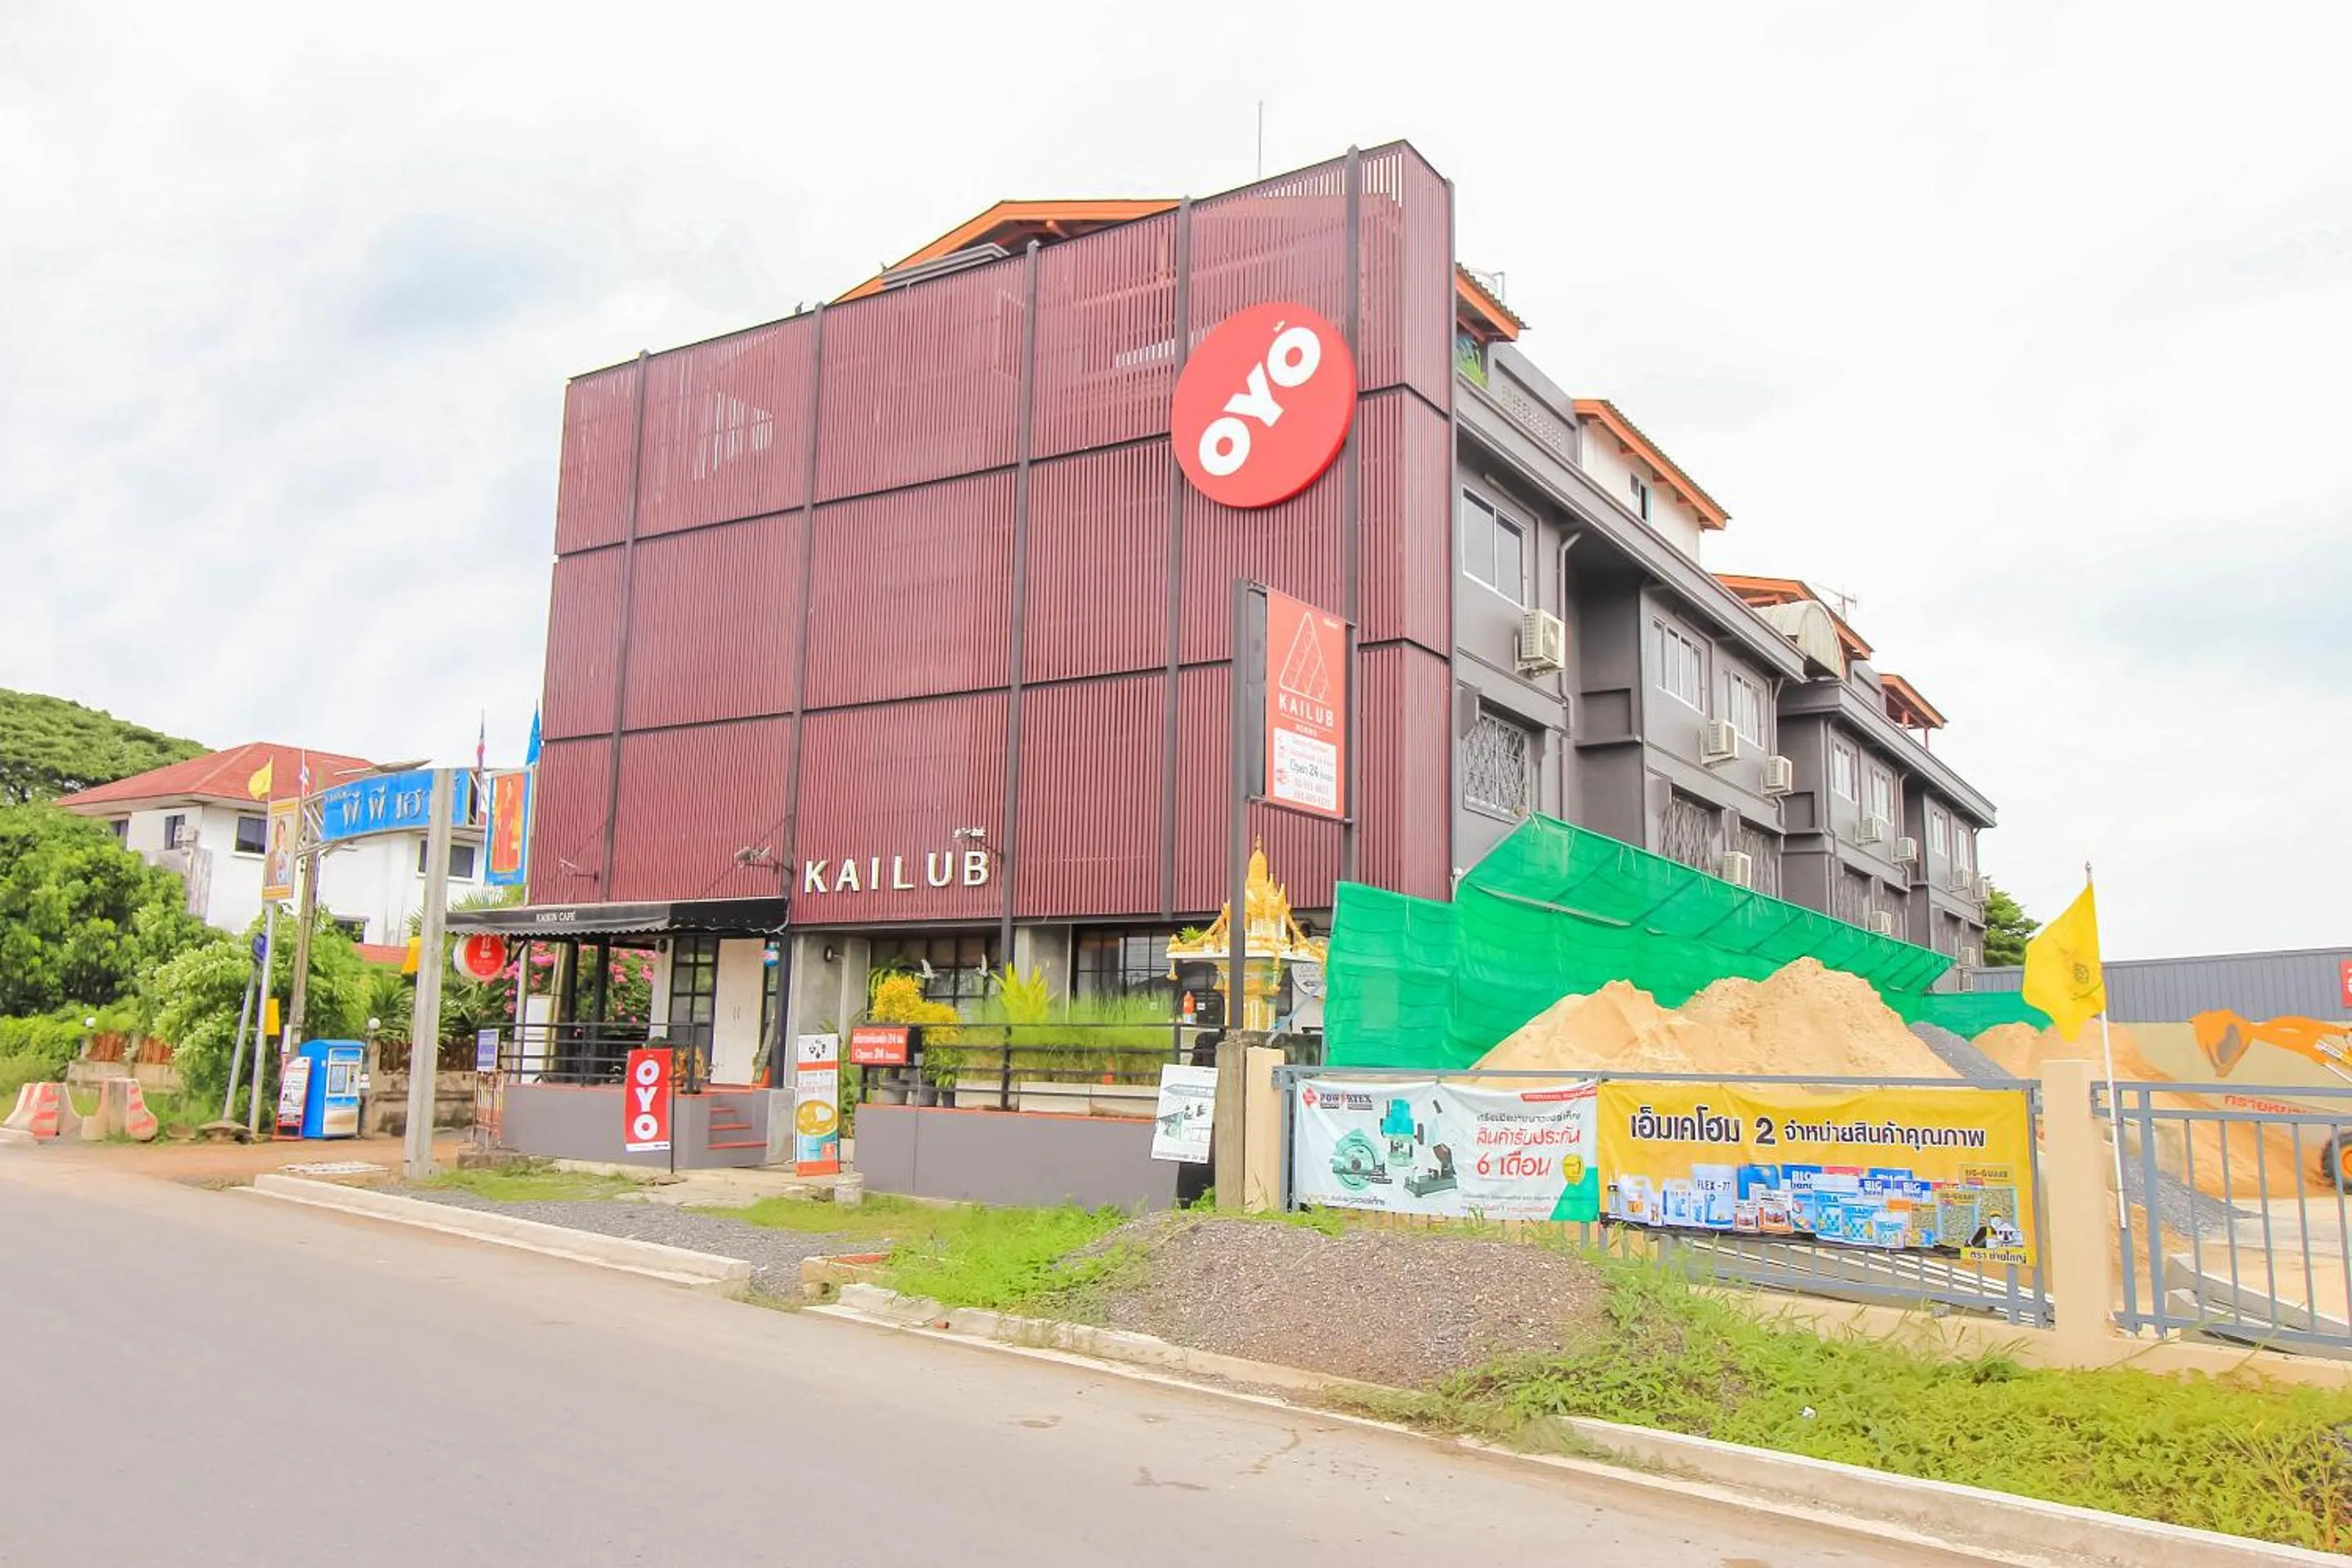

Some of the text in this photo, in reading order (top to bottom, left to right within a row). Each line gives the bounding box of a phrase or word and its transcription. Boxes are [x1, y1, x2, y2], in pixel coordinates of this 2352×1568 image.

[1199, 327, 1321, 476] OYO
[1279, 693, 1334, 727] KAILUB
[1309, 764, 1320, 777] 24
[804, 849, 990, 893] KAILUB
[634, 1058, 660, 1140] OYO
[1477, 1125, 1581, 1145] สินค้ารับประกัน
[1631, 1106, 1985, 1152] เอ็มเคโฮม 2 จำหน่ายสินค้าคุณภาพ
[1477, 1150, 1552, 1176] 6 เดือน
